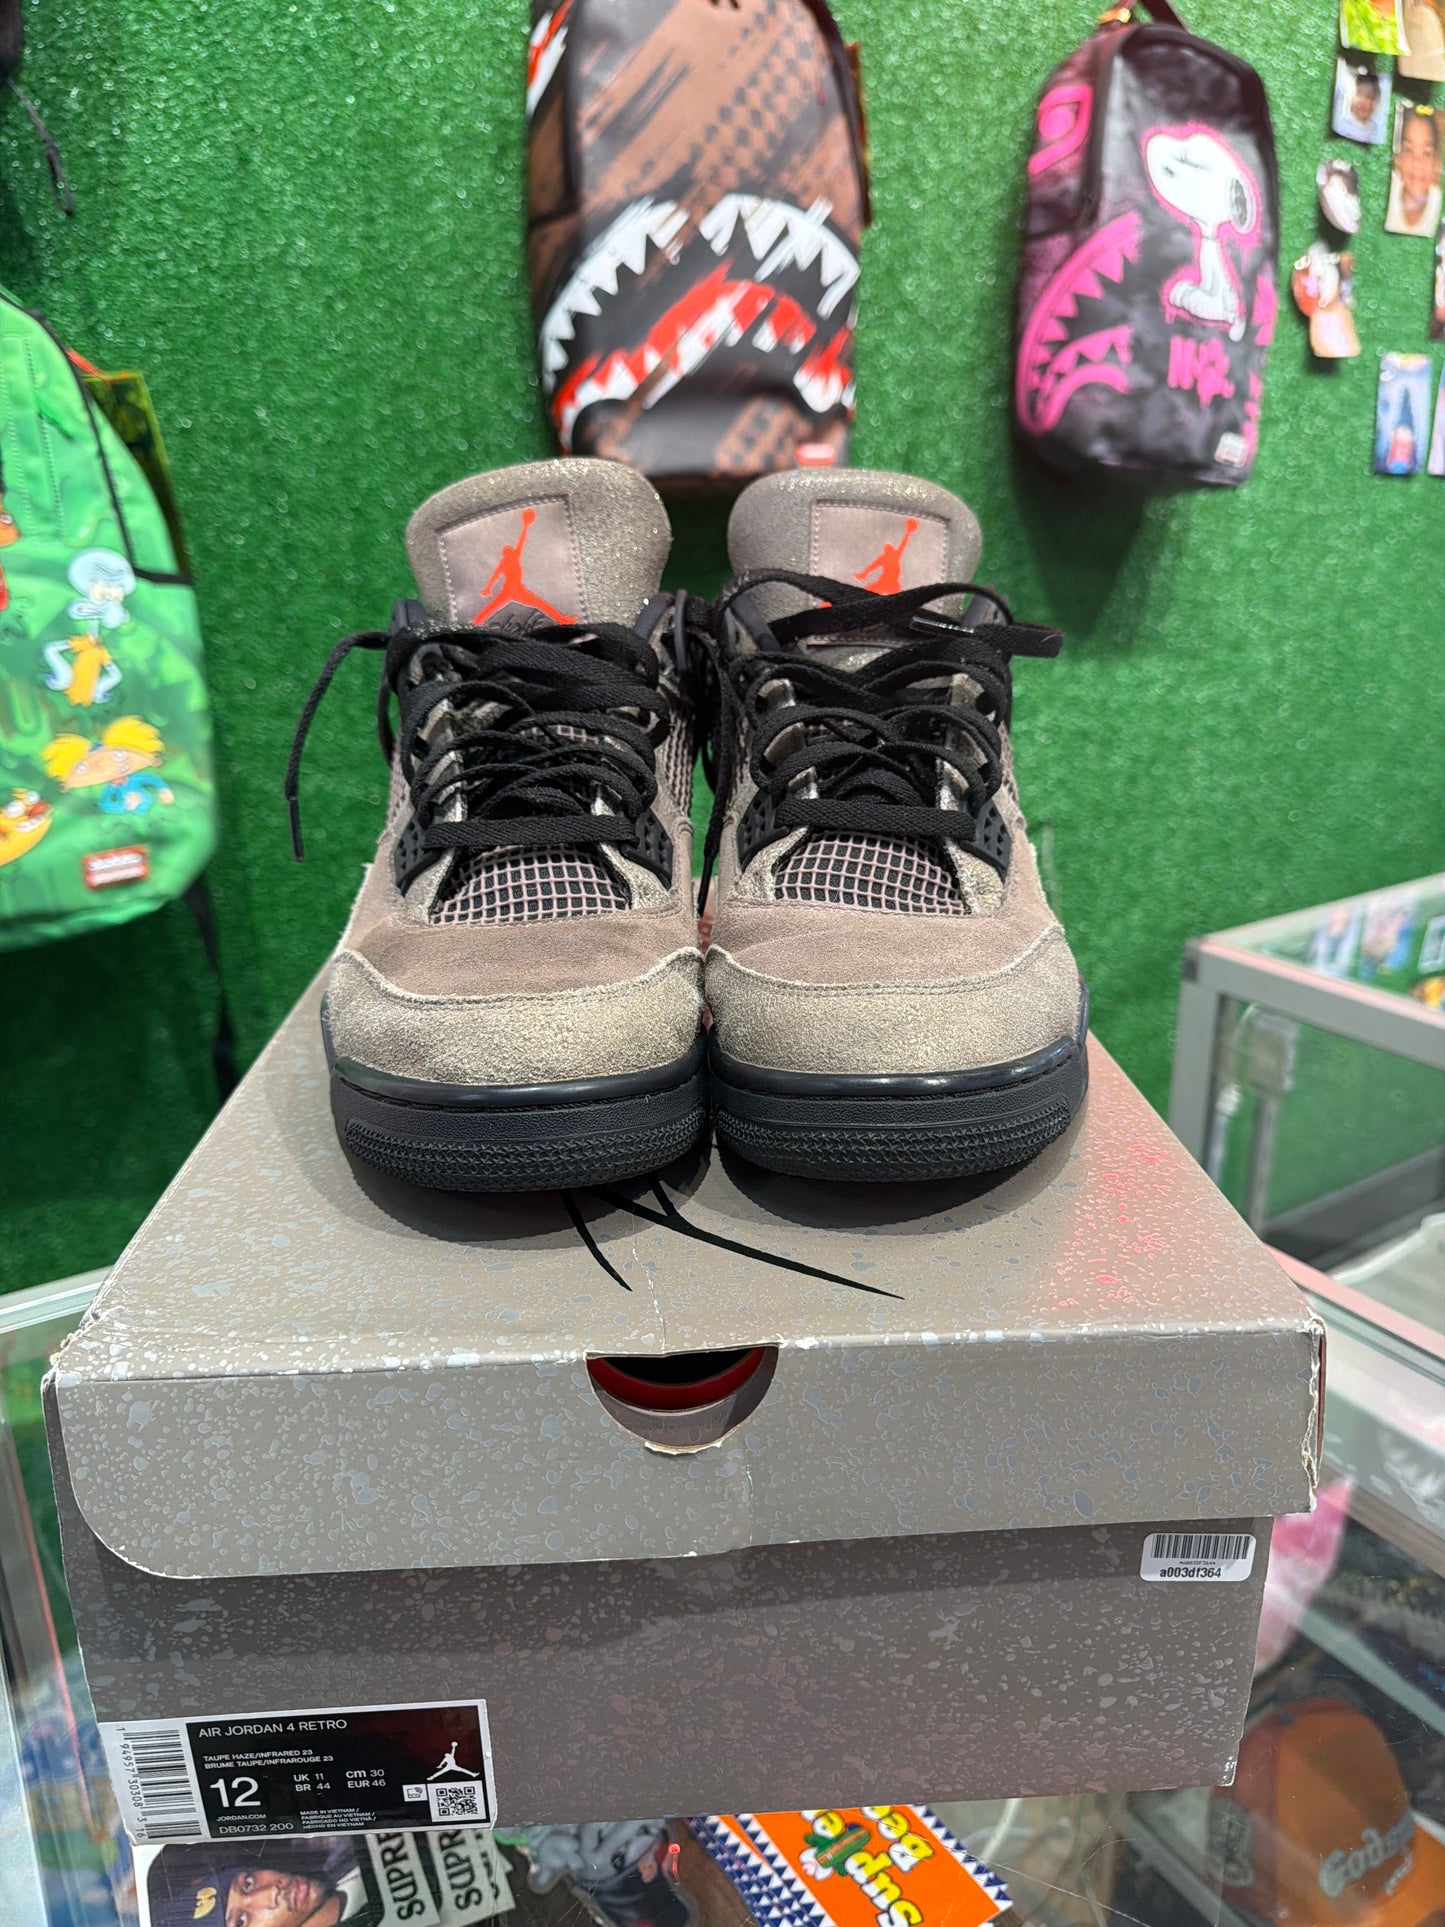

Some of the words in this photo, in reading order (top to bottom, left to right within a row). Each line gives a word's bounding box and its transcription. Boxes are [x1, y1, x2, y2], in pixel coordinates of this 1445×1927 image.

[1159, 1567, 1222, 1578] a003df364
[198, 1727, 222, 1738] AIR
[225, 1723, 283, 1737] JORDAN
[287, 1722, 295, 1732] 4
[299, 1719, 348, 1731] RETRO
[120, 1743, 135, 1773] 94957
[203, 1754, 230, 1762] TAUPE
[232, 1750, 301, 1760] HAZE/INFRARED
[236, 1757, 322, 1768] TAUPE/INFRAROUGE
[293, 1773, 310, 1782] UK
[314, 1773, 324, 1781] 11
[345, 1770, 367, 1779] cm
[370, 1769, 385, 1777] 30
[295, 1783, 311, 1792] BR
[316, 1782, 331, 1790] 44
[347, 1780, 370, 1789] EUR
[371, 1779, 386, 1787] 46
[127, 1778, 143, 1808] 30308
[210, 1776, 262, 1808] 12
[216, 1813, 267, 1822] JORDAN.COM
[219, 1824, 267, 1834] DB0732
[270, 1822, 294, 1831] 200
